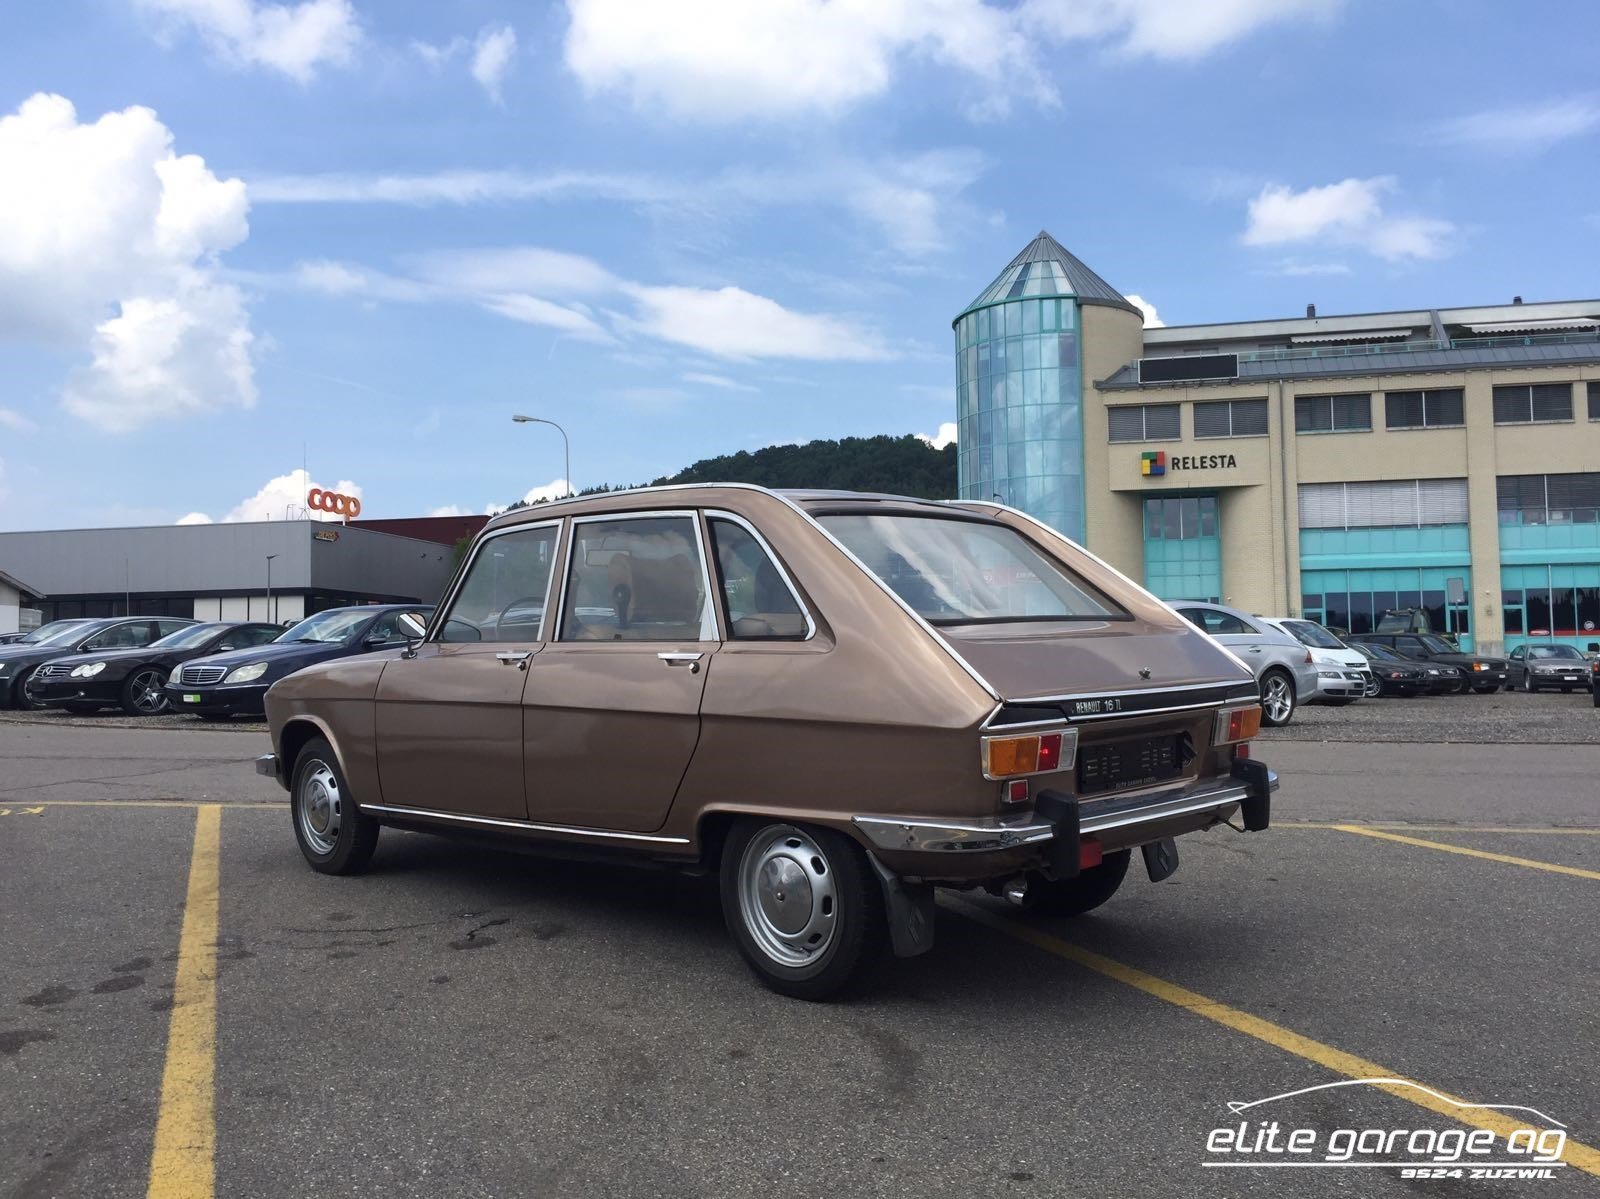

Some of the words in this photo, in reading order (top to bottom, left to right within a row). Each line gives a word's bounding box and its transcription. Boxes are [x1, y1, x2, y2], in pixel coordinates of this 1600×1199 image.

[1171, 454, 1237, 470] RELESTA
[1075, 700, 1100, 713] RENAULT
[1104, 699, 1114, 711] 16
